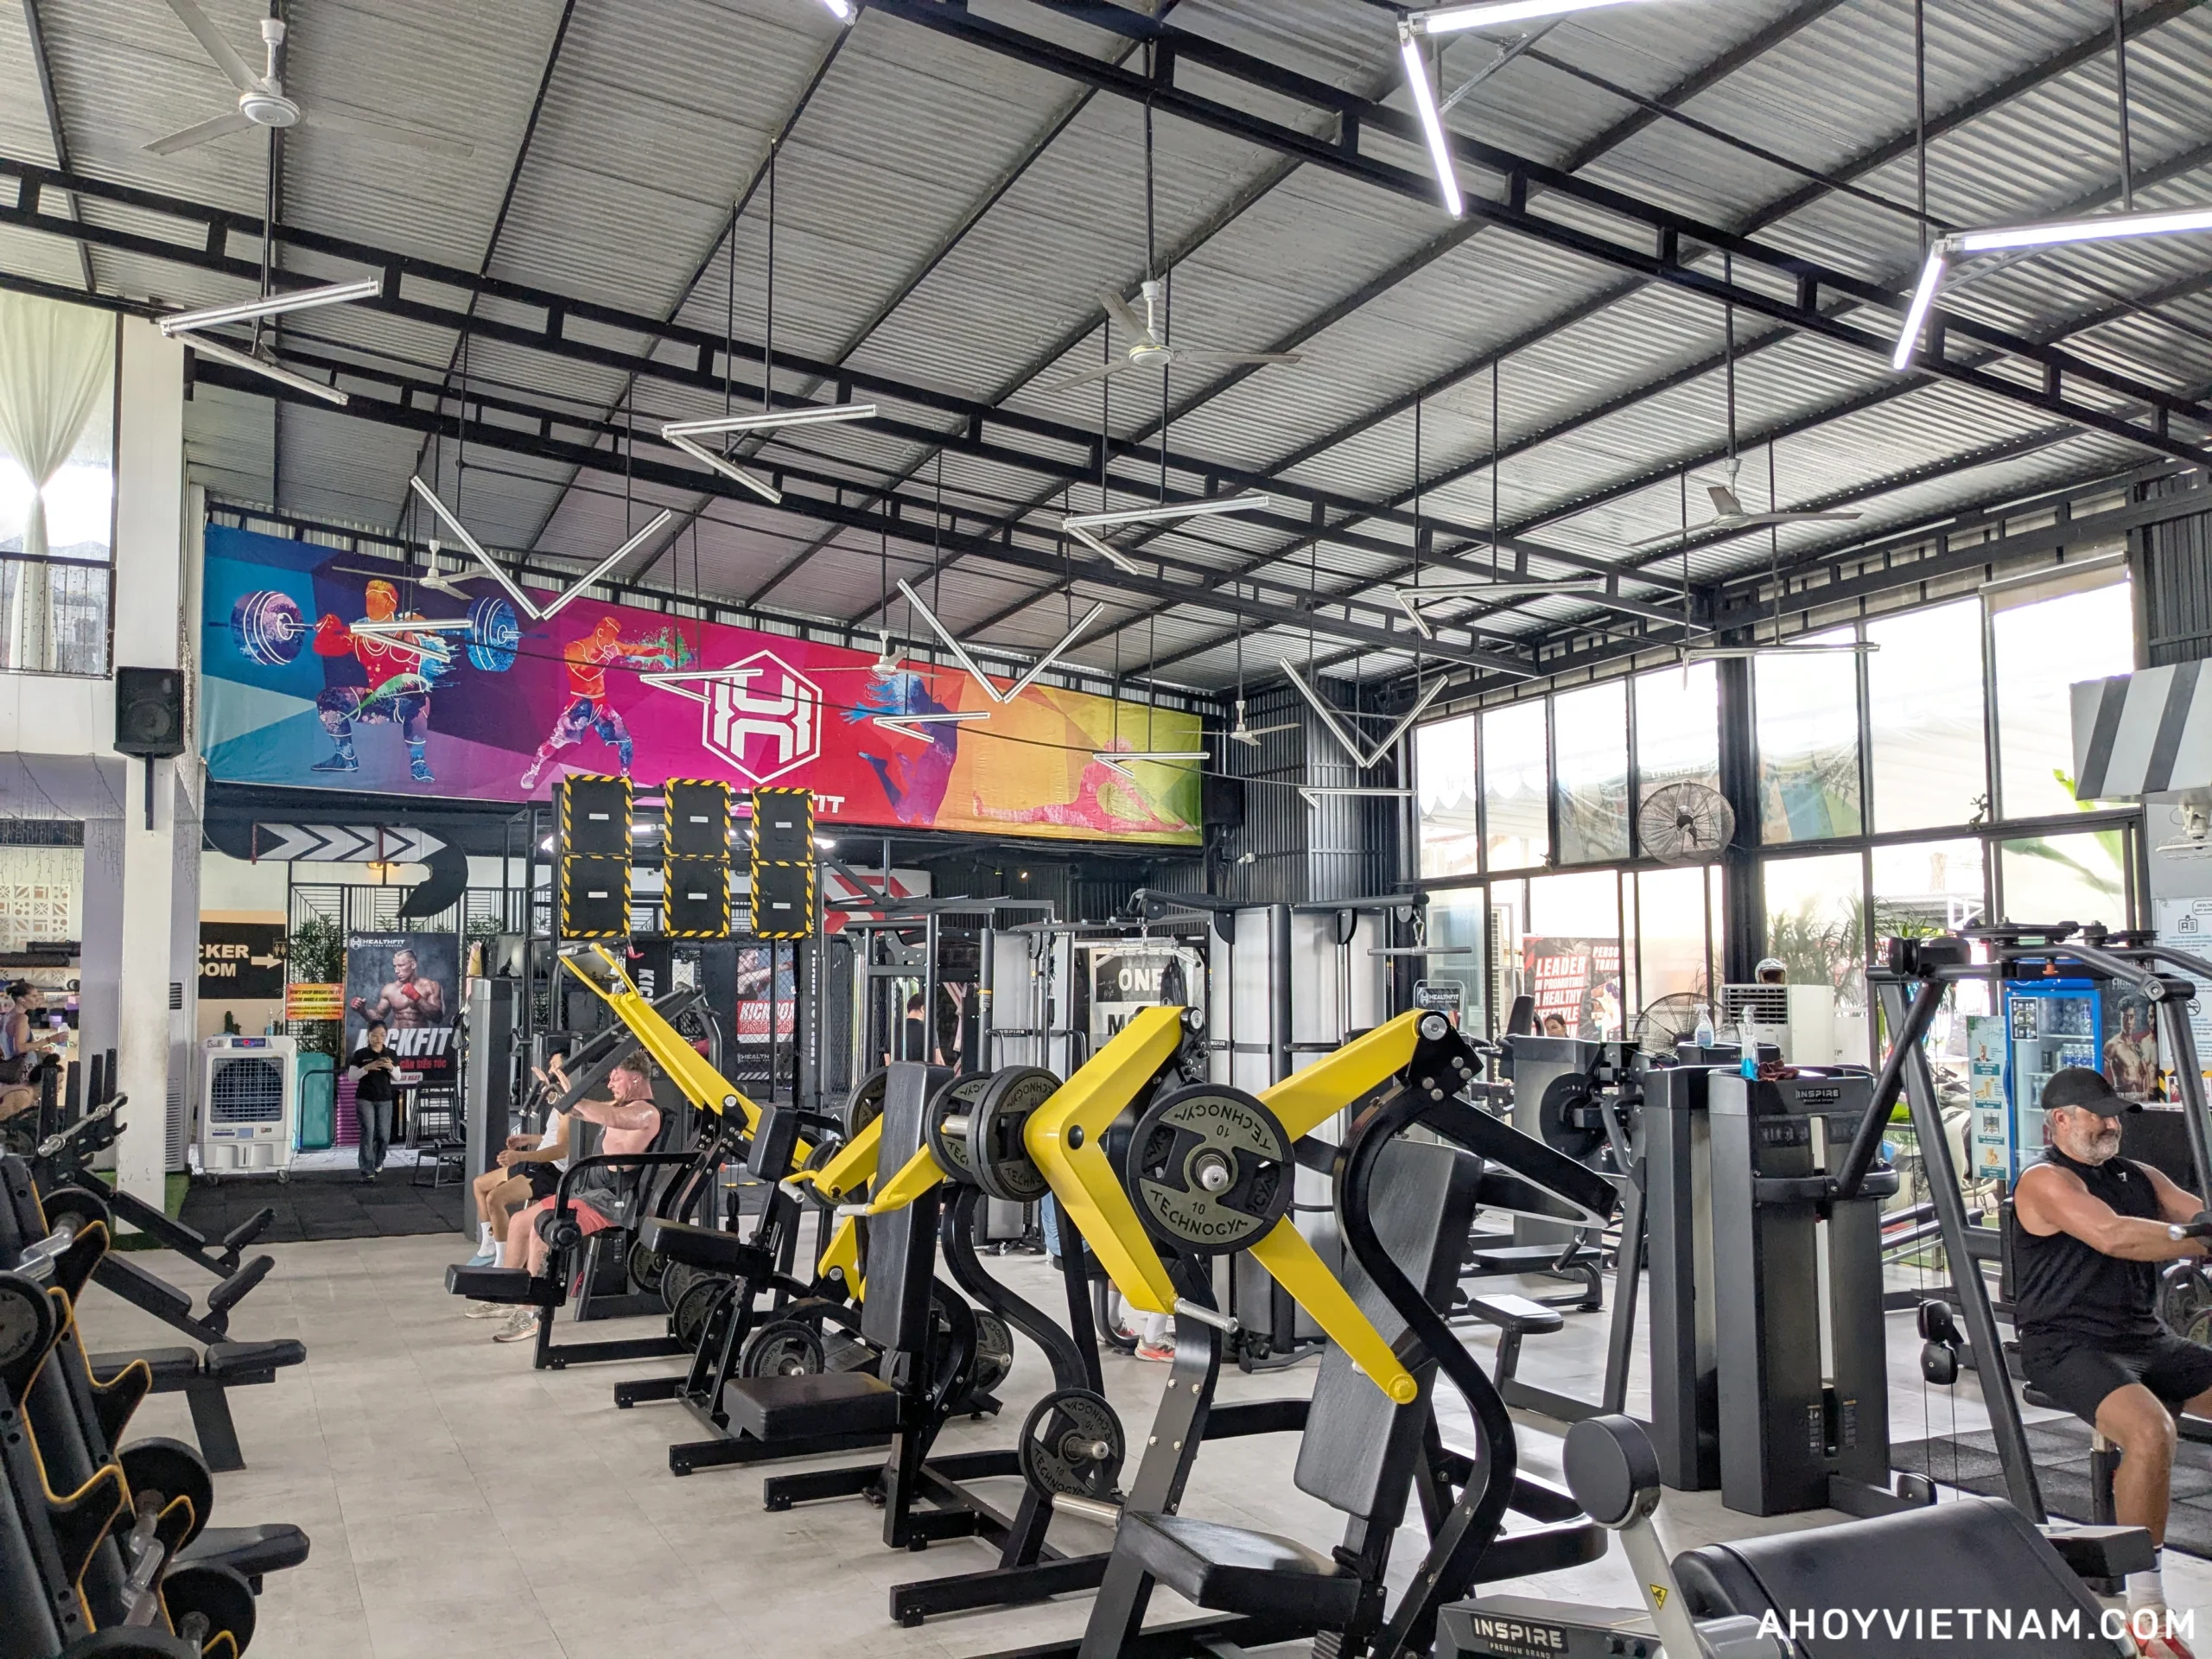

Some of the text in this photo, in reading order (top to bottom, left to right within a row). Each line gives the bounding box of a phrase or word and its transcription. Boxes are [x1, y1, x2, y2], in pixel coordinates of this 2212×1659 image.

[1535, 956, 1586, 977] LEADER
[1118, 968, 1165, 991] ONE
[1535, 976, 1584, 991] IN PROMOTING
[1535, 989, 1582, 1007] A HEALTHY
[740, 1020, 770, 1033] FASTE
[1108, 1014, 1137, 1036] M
[1007, 1081, 1053, 1108] ECHNOGYM
[1796, 1089, 1839, 1098] INSPIRE
[1174, 1104, 1272, 1151] TECHNOGYM
[1217, 1124, 1230, 1138] 10
[1150, 1189, 1249, 1236] TECHNOGYM
[1192, 1201, 1206, 1216] 10
[984, 1320, 1007, 1351] CHNOGYM
[1065, 1402, 1115, 1450] TECHNOGYM
[1085, 1421, 1094, 1431] 10
[1035, 1447, 1085, 1496] TECHNOGYM
[1056, 1466, 1065, 1477] 10
[1474, 1618, 1563, 1649] INSPIRE
[1490, 1642, 1551, 1659] PREMIUM BRAND
